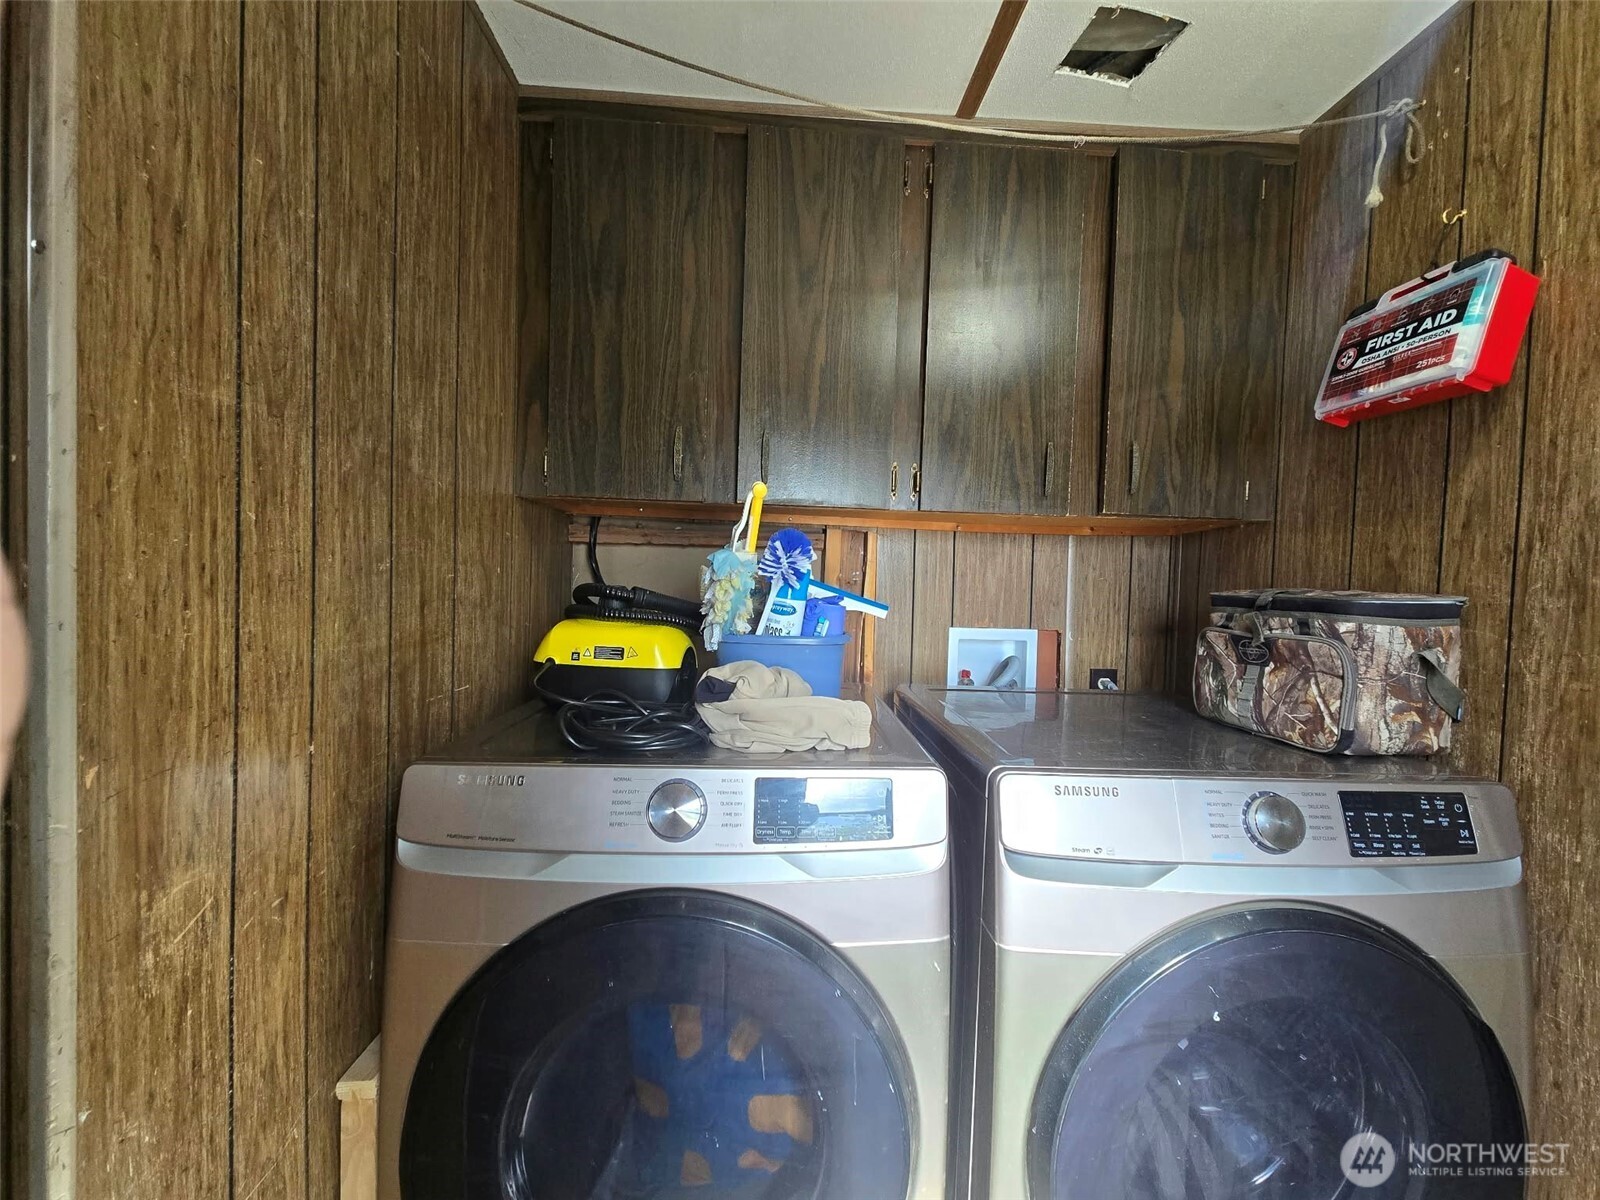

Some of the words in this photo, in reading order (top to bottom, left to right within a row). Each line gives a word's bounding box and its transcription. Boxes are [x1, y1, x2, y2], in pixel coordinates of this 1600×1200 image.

[1364, 322, 1419, 353] FIRST
[1418, 308, 1457, 333] AID
[1361, 353, 1381, 364] OSHA
[1382, 345, 1401, 356] ANSI
[457, 774, 526, 787] SMSUNG
[1054, 784, 1119, 797] SAMSUNG
